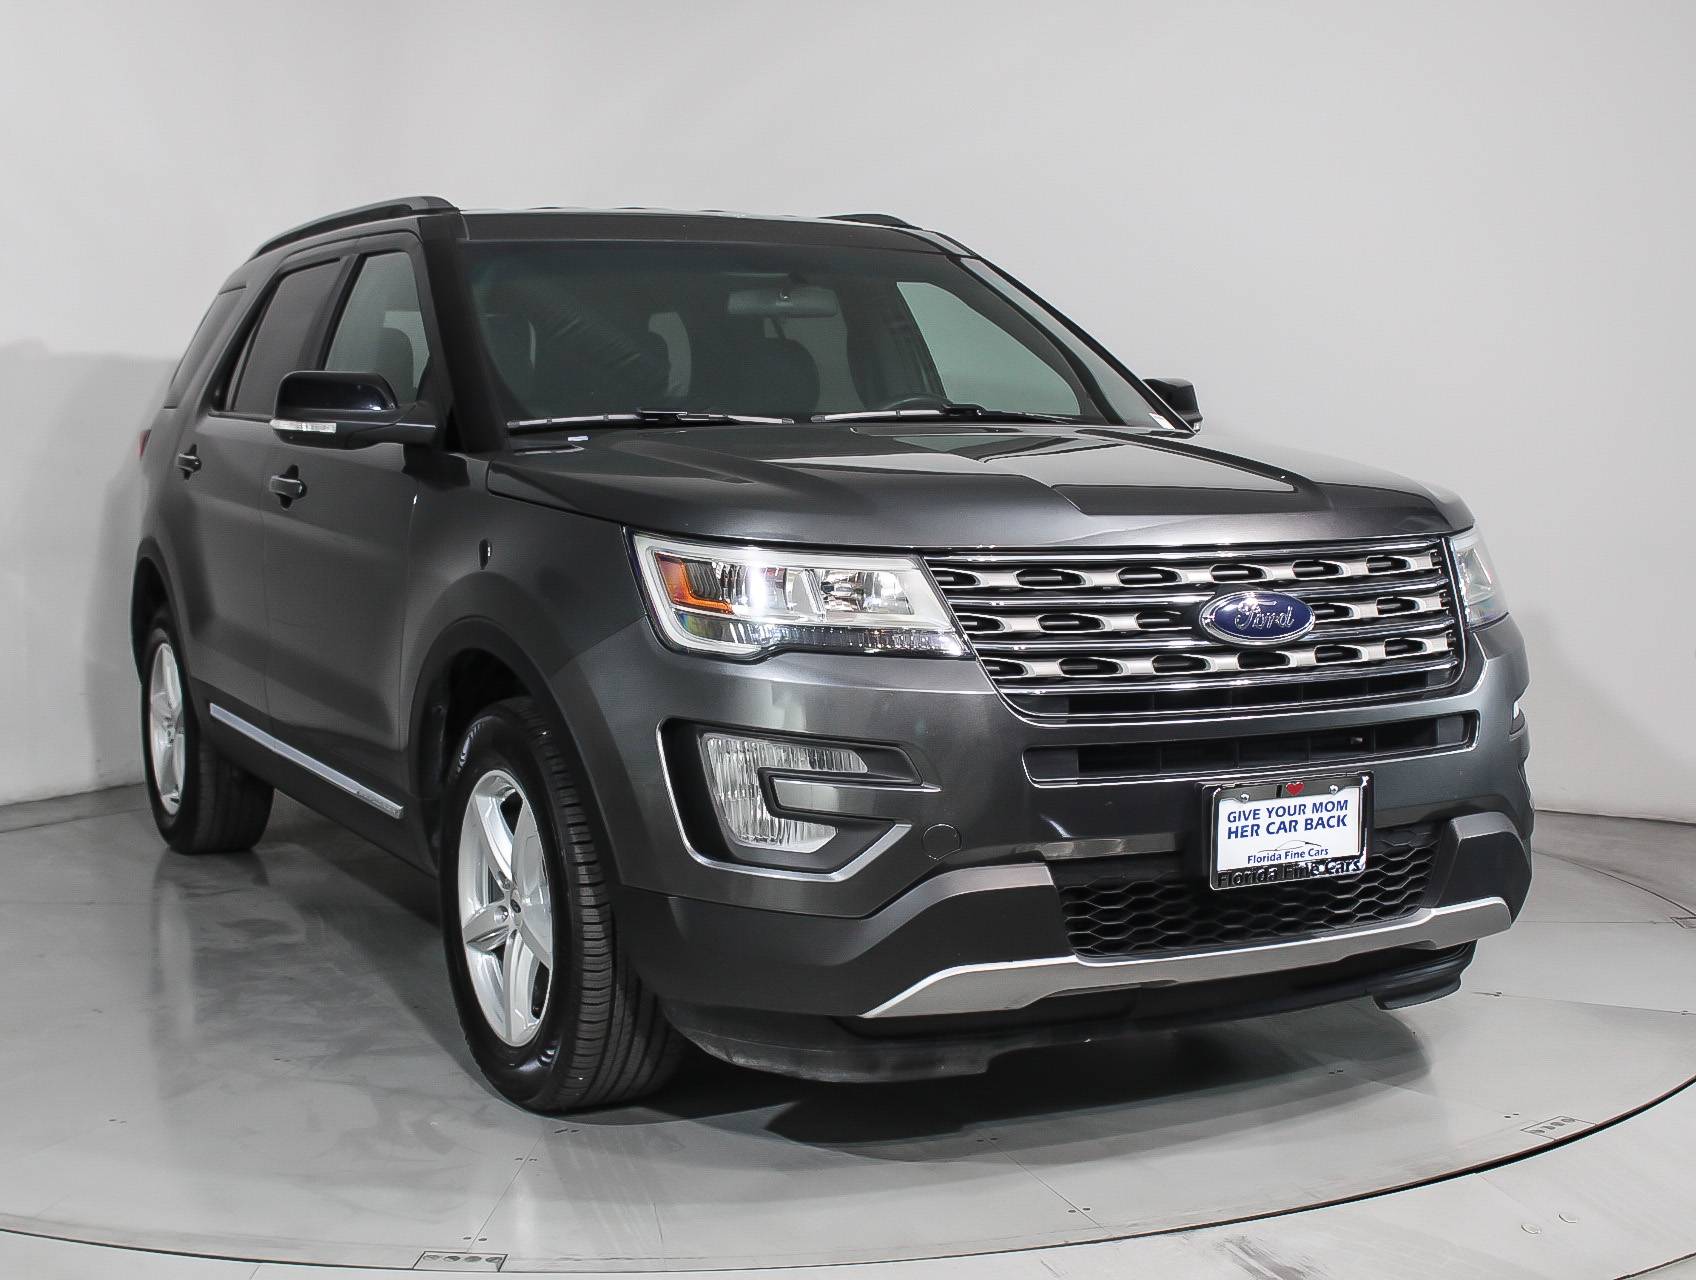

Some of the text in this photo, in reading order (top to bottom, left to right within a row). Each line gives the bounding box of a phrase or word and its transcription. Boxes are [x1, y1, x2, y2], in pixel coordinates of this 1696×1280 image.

[1235, 598, 1295, 630] Ford
[1227, 799, 1348, 823] GIVE YOUR MOM
[1227, 814, 1348, 839] HER CAR BACK
[1247, 847, 1329, 864] Florida Fine Cars
[1217, 857, 1361, 888] Florida Fine Cars
